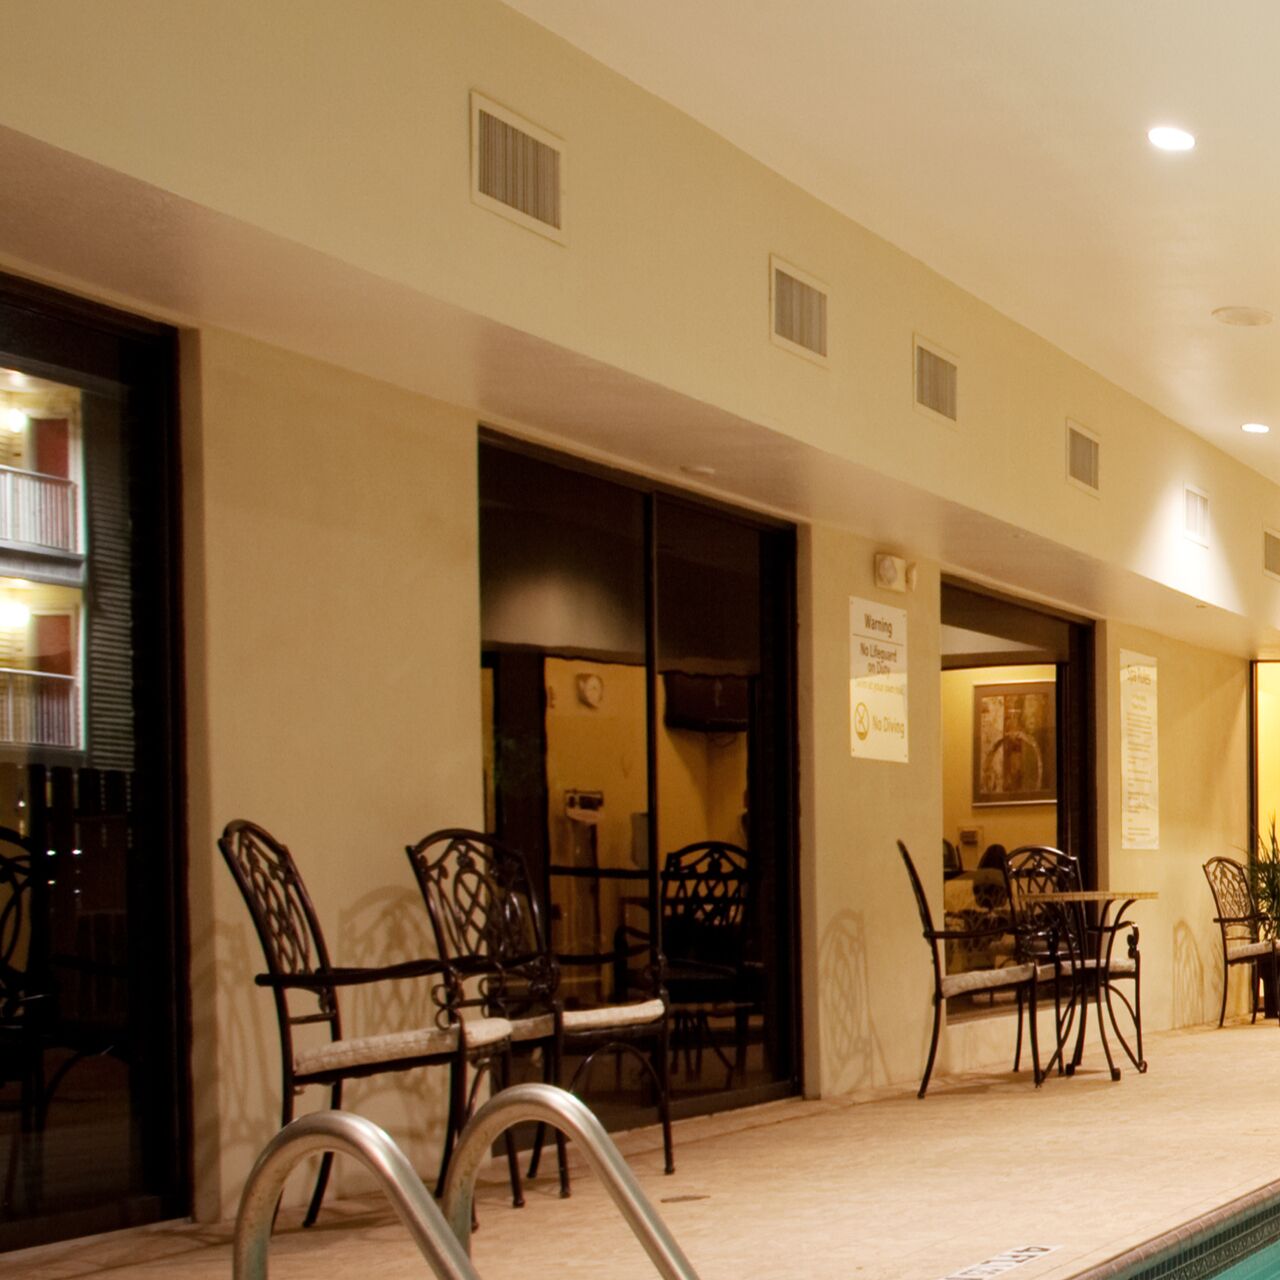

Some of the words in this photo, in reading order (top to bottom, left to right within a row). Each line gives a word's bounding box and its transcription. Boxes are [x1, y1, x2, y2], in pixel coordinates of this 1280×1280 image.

[864, 613, 893, 638] Warning
[860, 642, 868, 656] No
[870, 643, 897, 663] Lifeguard
[868, 663, 877, 673] on
[877, 661, 891, 676] Duty
[873, 715, 881, 731] No
[884, 715, 905, 739] Diving
